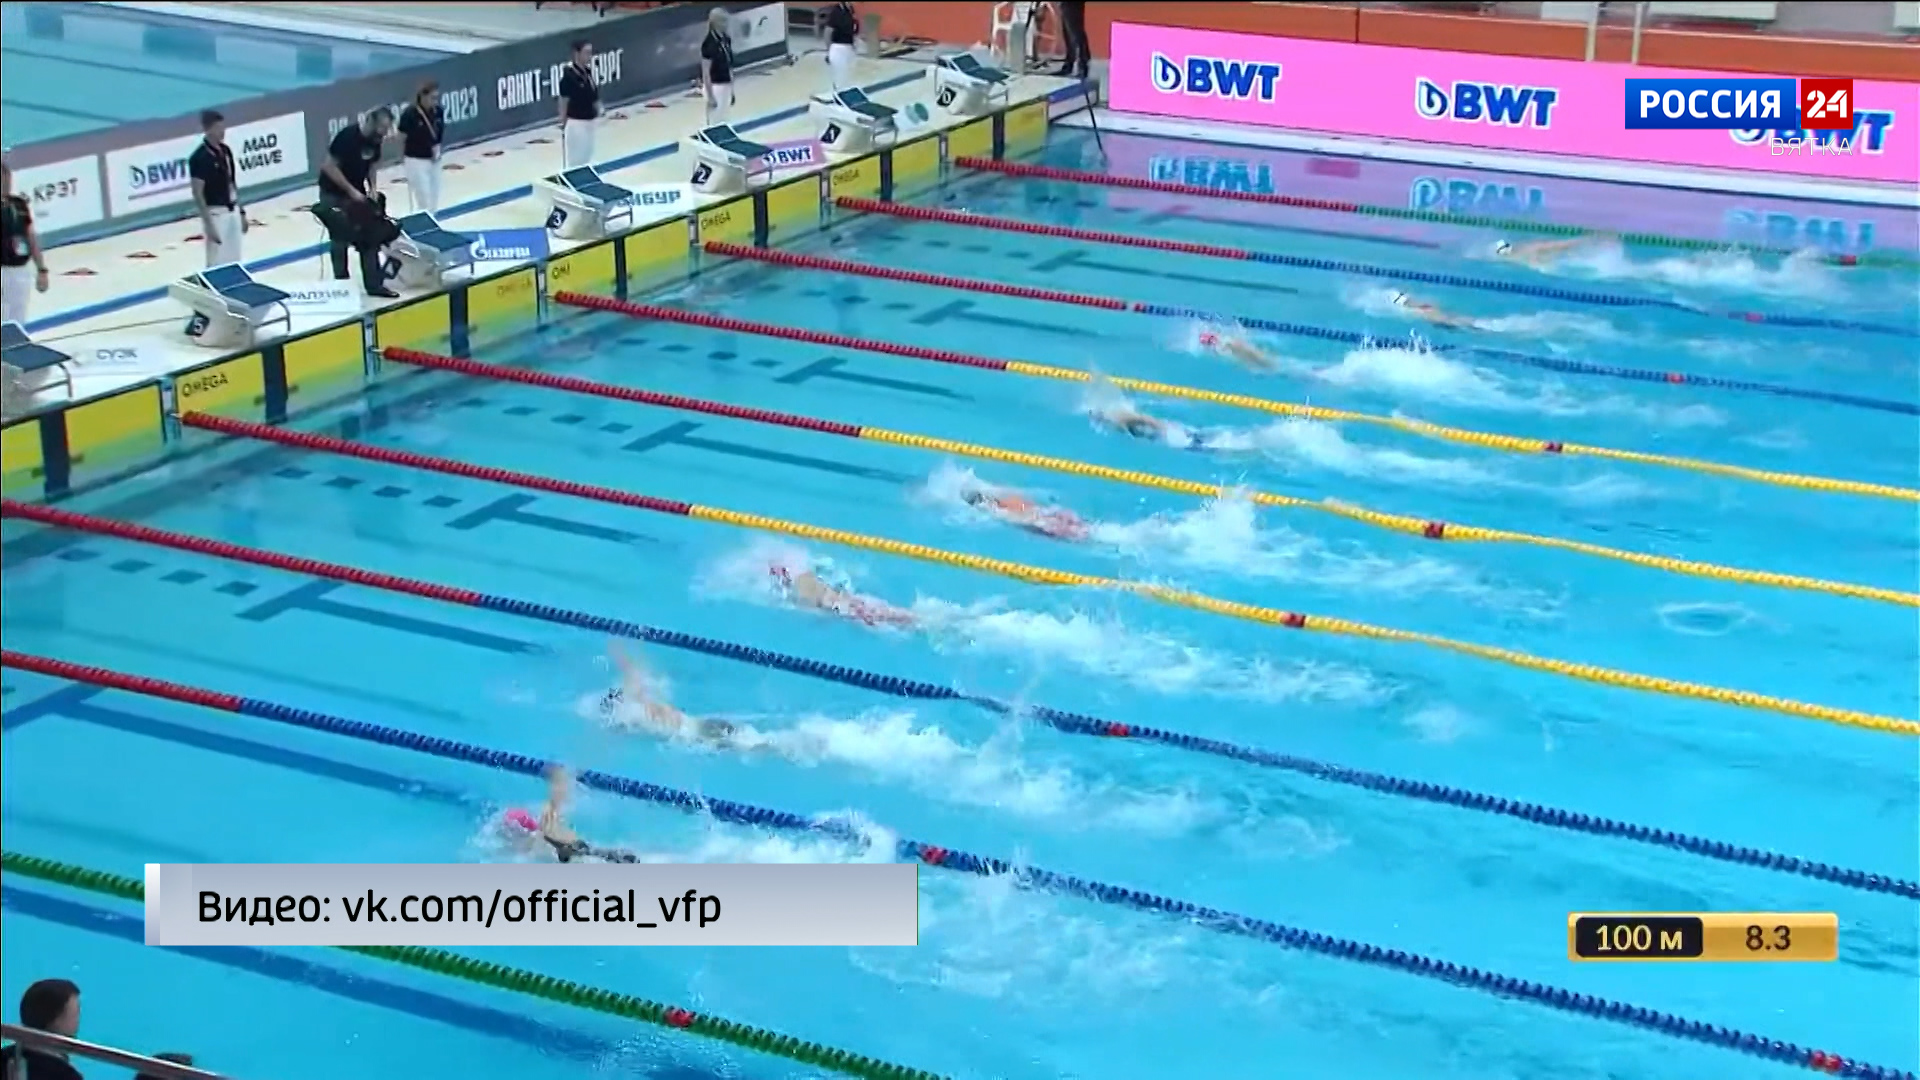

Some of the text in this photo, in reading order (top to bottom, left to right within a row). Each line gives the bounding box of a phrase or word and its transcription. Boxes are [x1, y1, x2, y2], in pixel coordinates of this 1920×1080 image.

[1187, 58, 1280, 100] BWT
[441, 85, 478, 124] 2023
[1453, 84, 1557, 126] BWT
[243, 133, 277, 154] MAD
[777, 146, 811, 163] BWT
[147, 158, 189, 184] BWT
[238, 149, 282, 171] WAVE
[33, 177, 79, 202] КРЭТ
[182, 373, 229, 397] OMEGA
